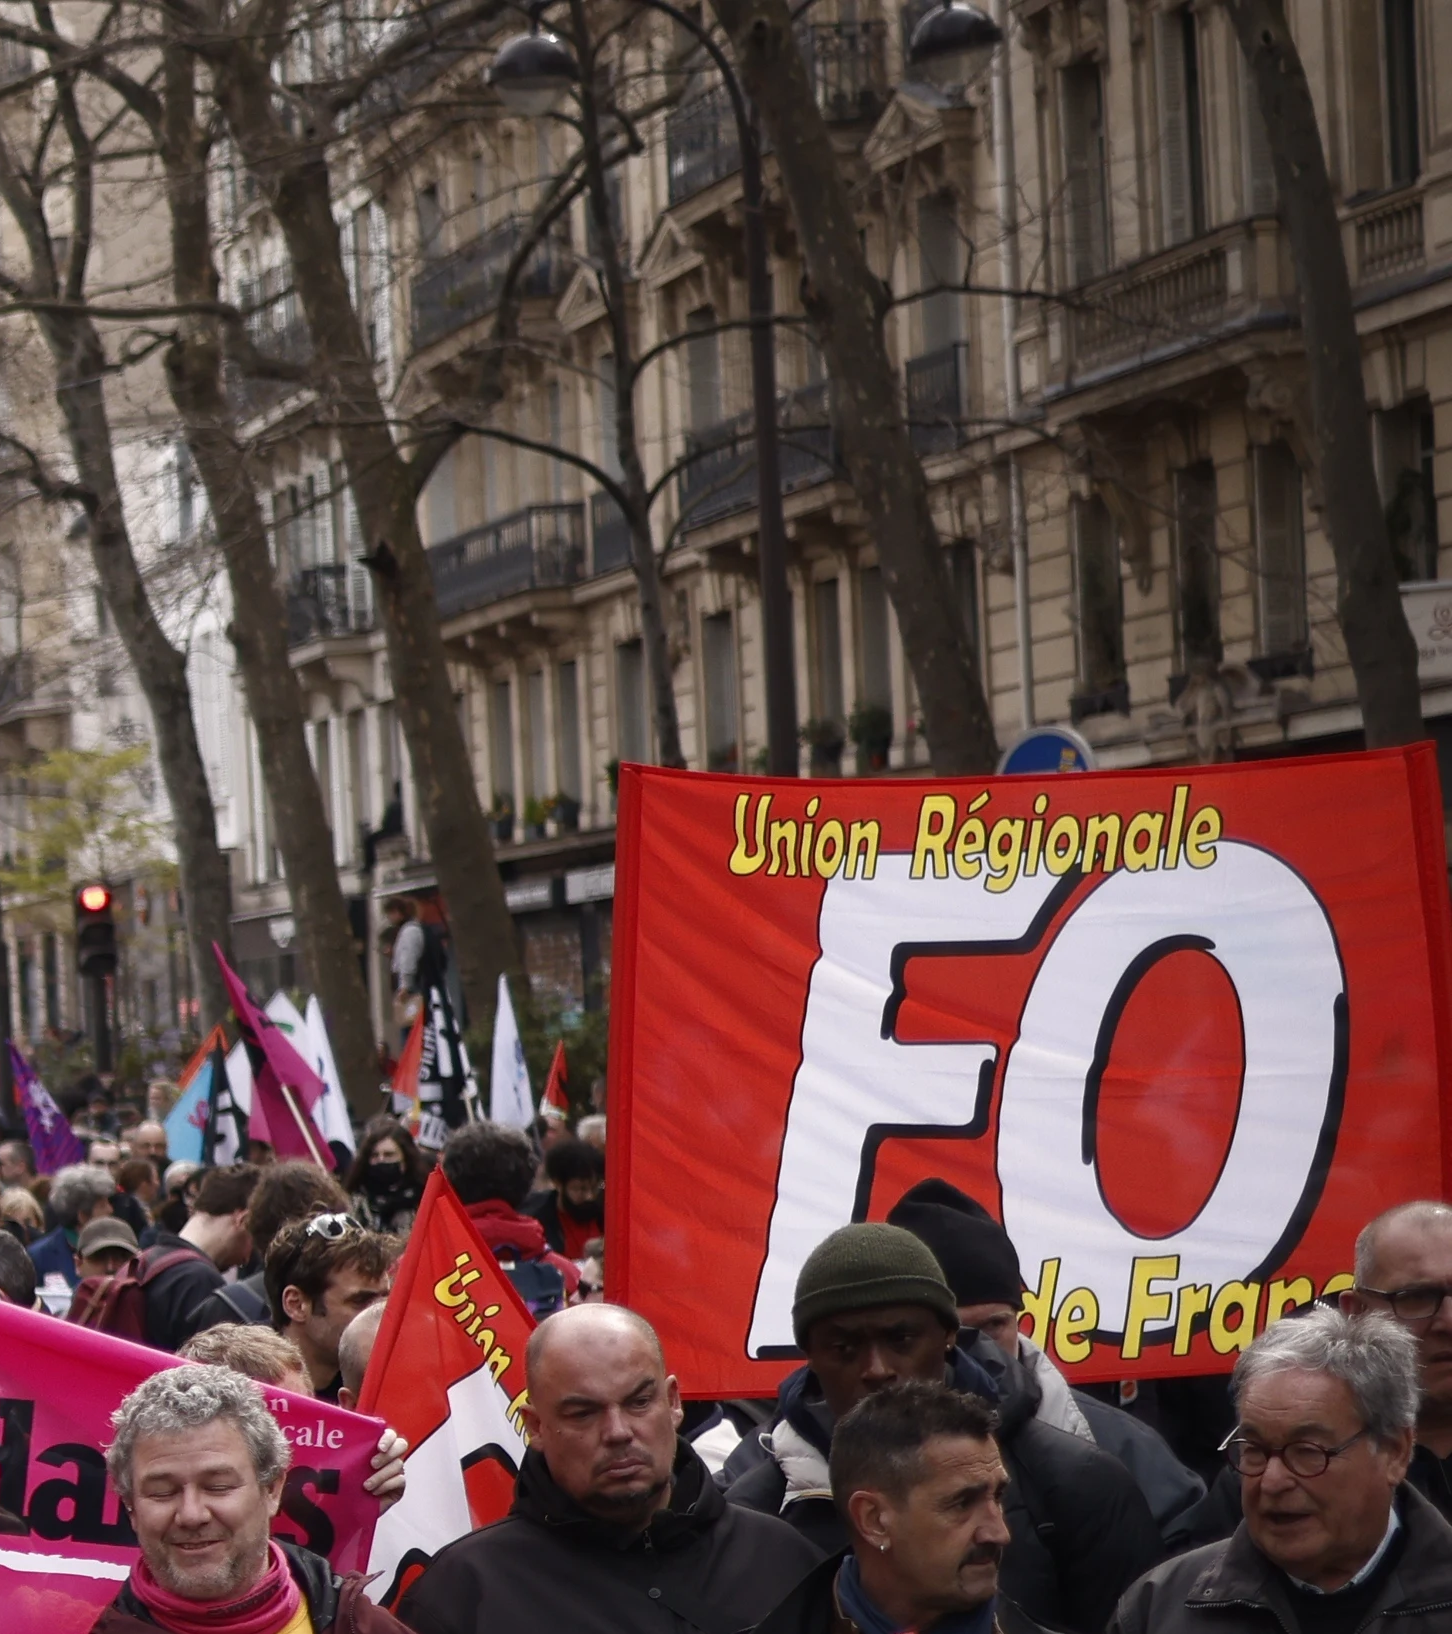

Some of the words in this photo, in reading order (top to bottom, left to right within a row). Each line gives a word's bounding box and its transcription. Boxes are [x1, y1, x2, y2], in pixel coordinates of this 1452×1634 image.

[728, 792, 881, 881] Union
[909, 784, 1225, 893] Régionale
[745, 836, 1350, 1361] FO
[433, 1251, 512, 1389] Union
